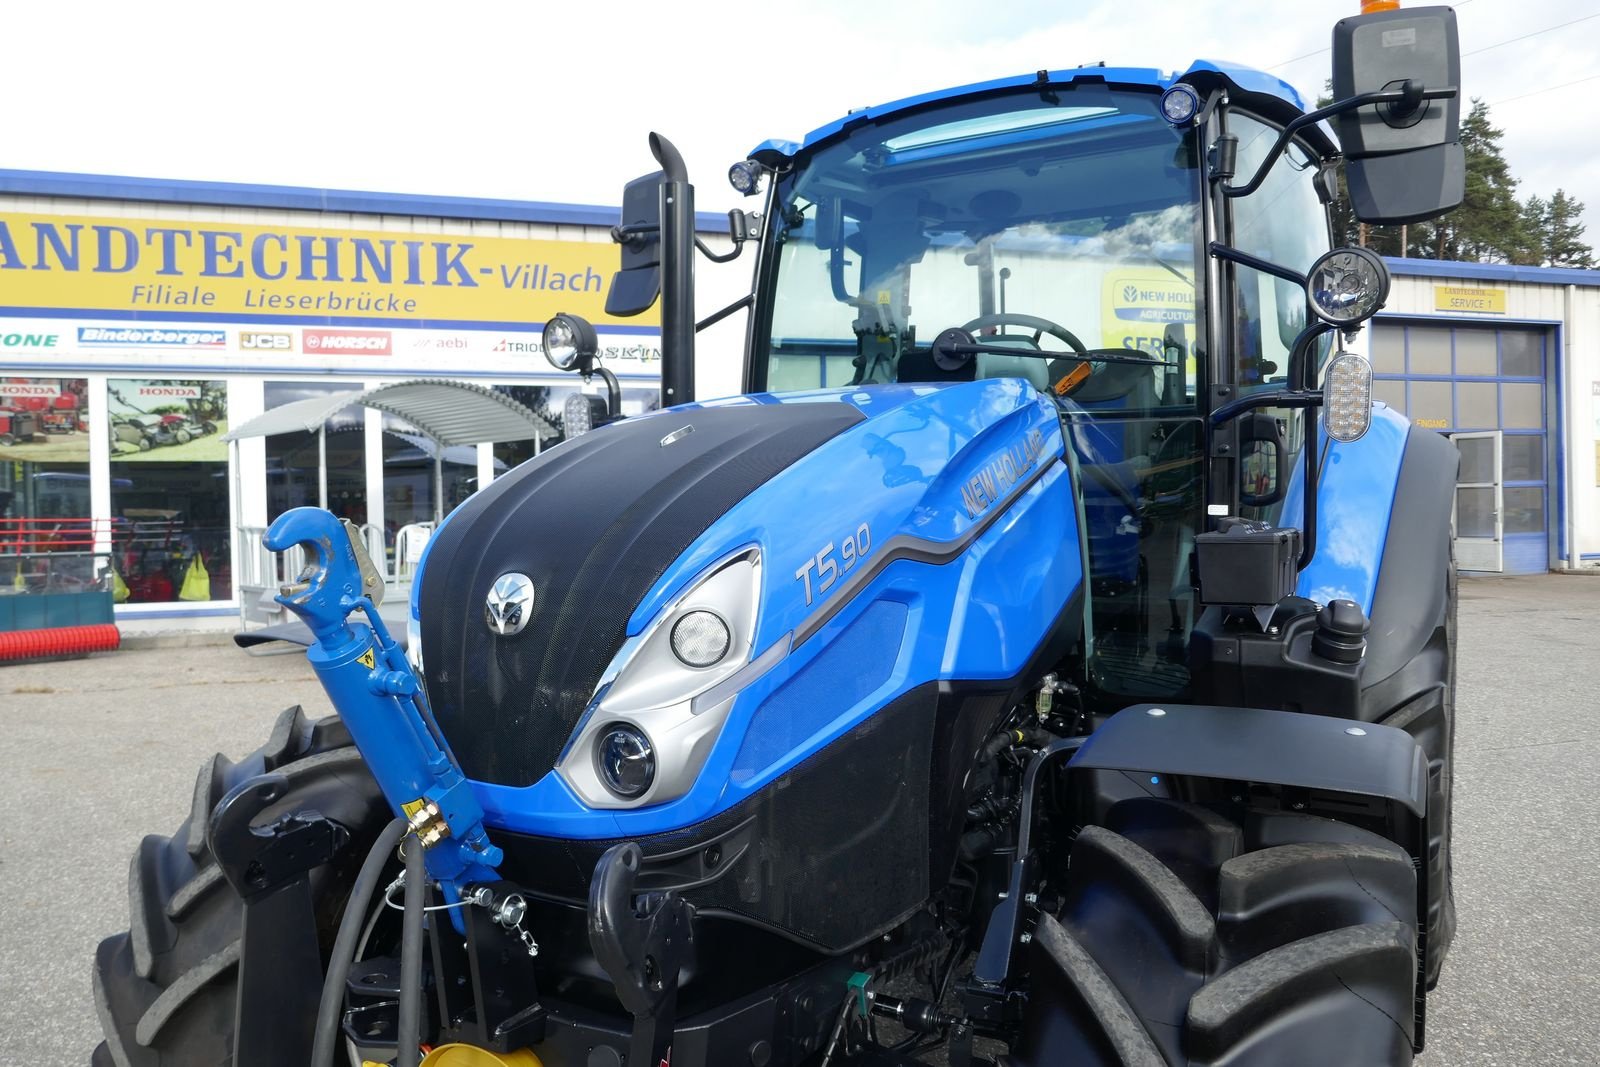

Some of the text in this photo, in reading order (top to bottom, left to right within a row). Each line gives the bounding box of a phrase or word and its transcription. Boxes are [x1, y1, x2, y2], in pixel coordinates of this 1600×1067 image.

[500, 264, 602, 293] Villach
[132, 285, 417, 313] Filiale Lieserbrücke
[1140, 291, 1165, 302] NEW
[1450, 298, 1492, 309] SERVICE 1
[0, 333, 59, 347] ONE
[80, 328, 223, 345] Binderberger
[242, 334, 290, 349] JCB
[320, 335, 388, 349] HORSCH
[436, 338, 468, 349] aebi
[139, 388, 197, 396] HONDA
[960, 462, 1001, 520] NEW
[795, 522, 872, 608] T5.90
